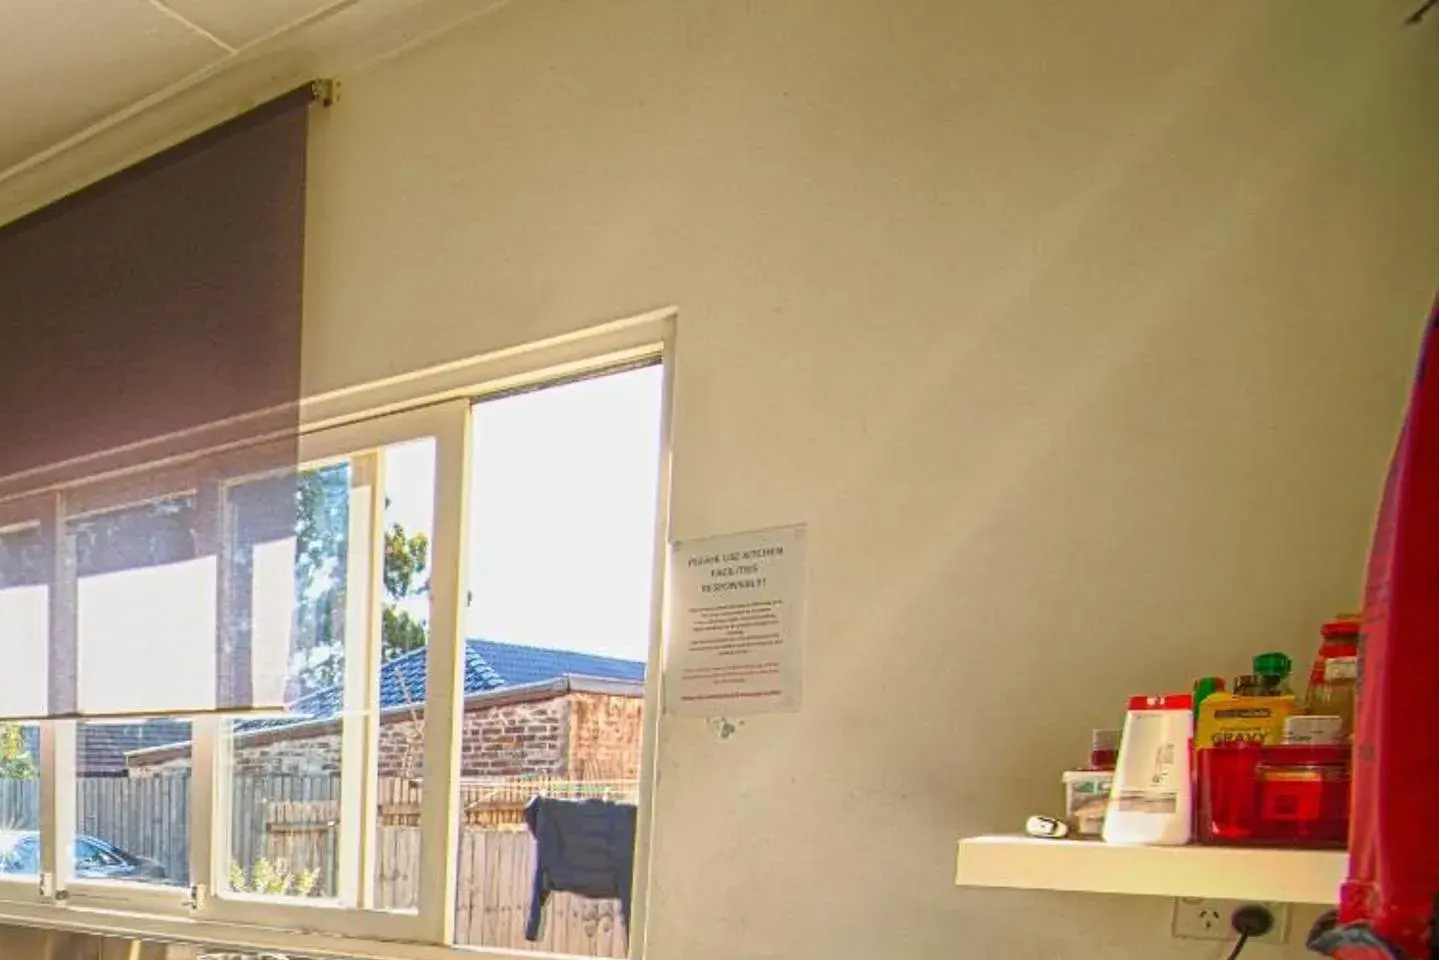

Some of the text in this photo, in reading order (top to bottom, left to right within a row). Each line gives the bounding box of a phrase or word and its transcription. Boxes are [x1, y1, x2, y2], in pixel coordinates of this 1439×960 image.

[722, 551, 741, 563] USE
[743, 546, 785, 561] KITCHEN
[1211, 732, 1270, 745] GRAVY
